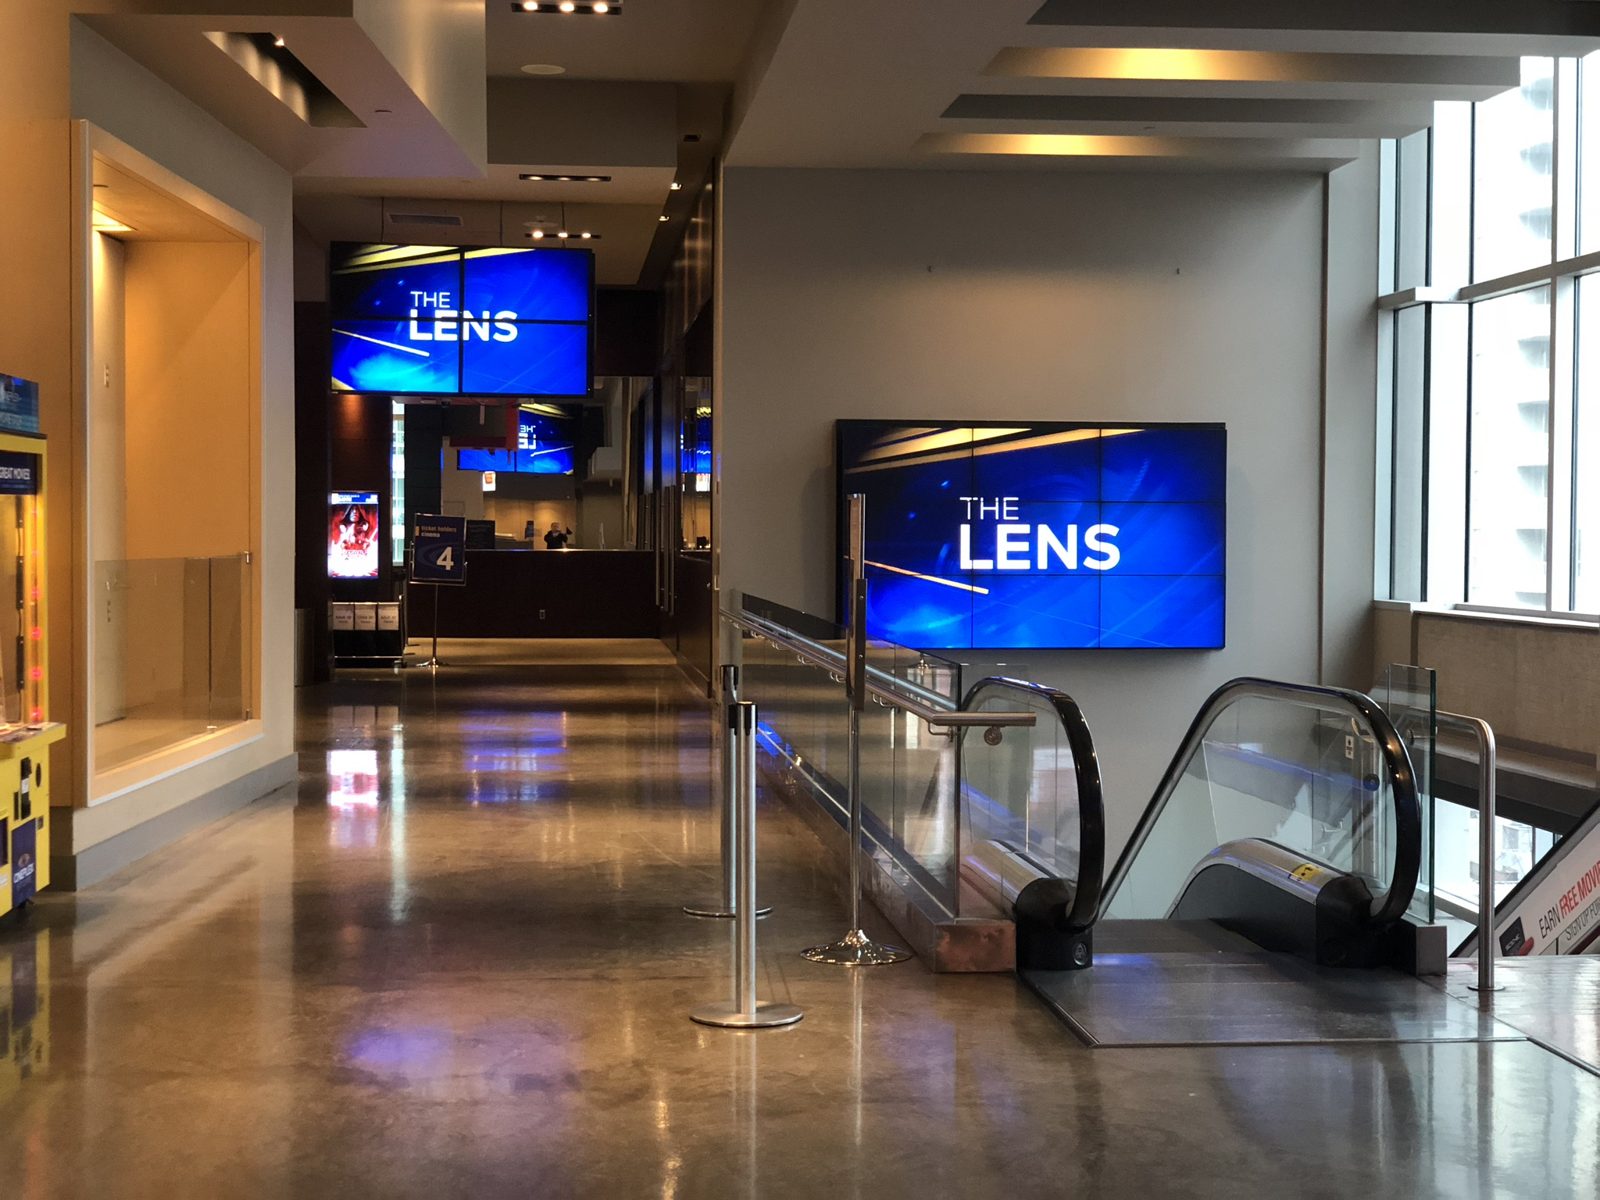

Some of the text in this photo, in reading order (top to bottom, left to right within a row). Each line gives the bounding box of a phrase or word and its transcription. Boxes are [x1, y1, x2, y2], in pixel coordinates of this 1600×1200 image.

[410, 291, 450, 308] THE
[409, 309, 518, 342] LENS
[960, 497, 1019, 520] THE
[436, 546, 454, 571] 4
[960, 524, 1120, 570] LENS
[1539, 904, 1561, 939] EARN
[1559, 885, 1579, 919] FREE
[1564, 917, 1582, 941] SIGN
